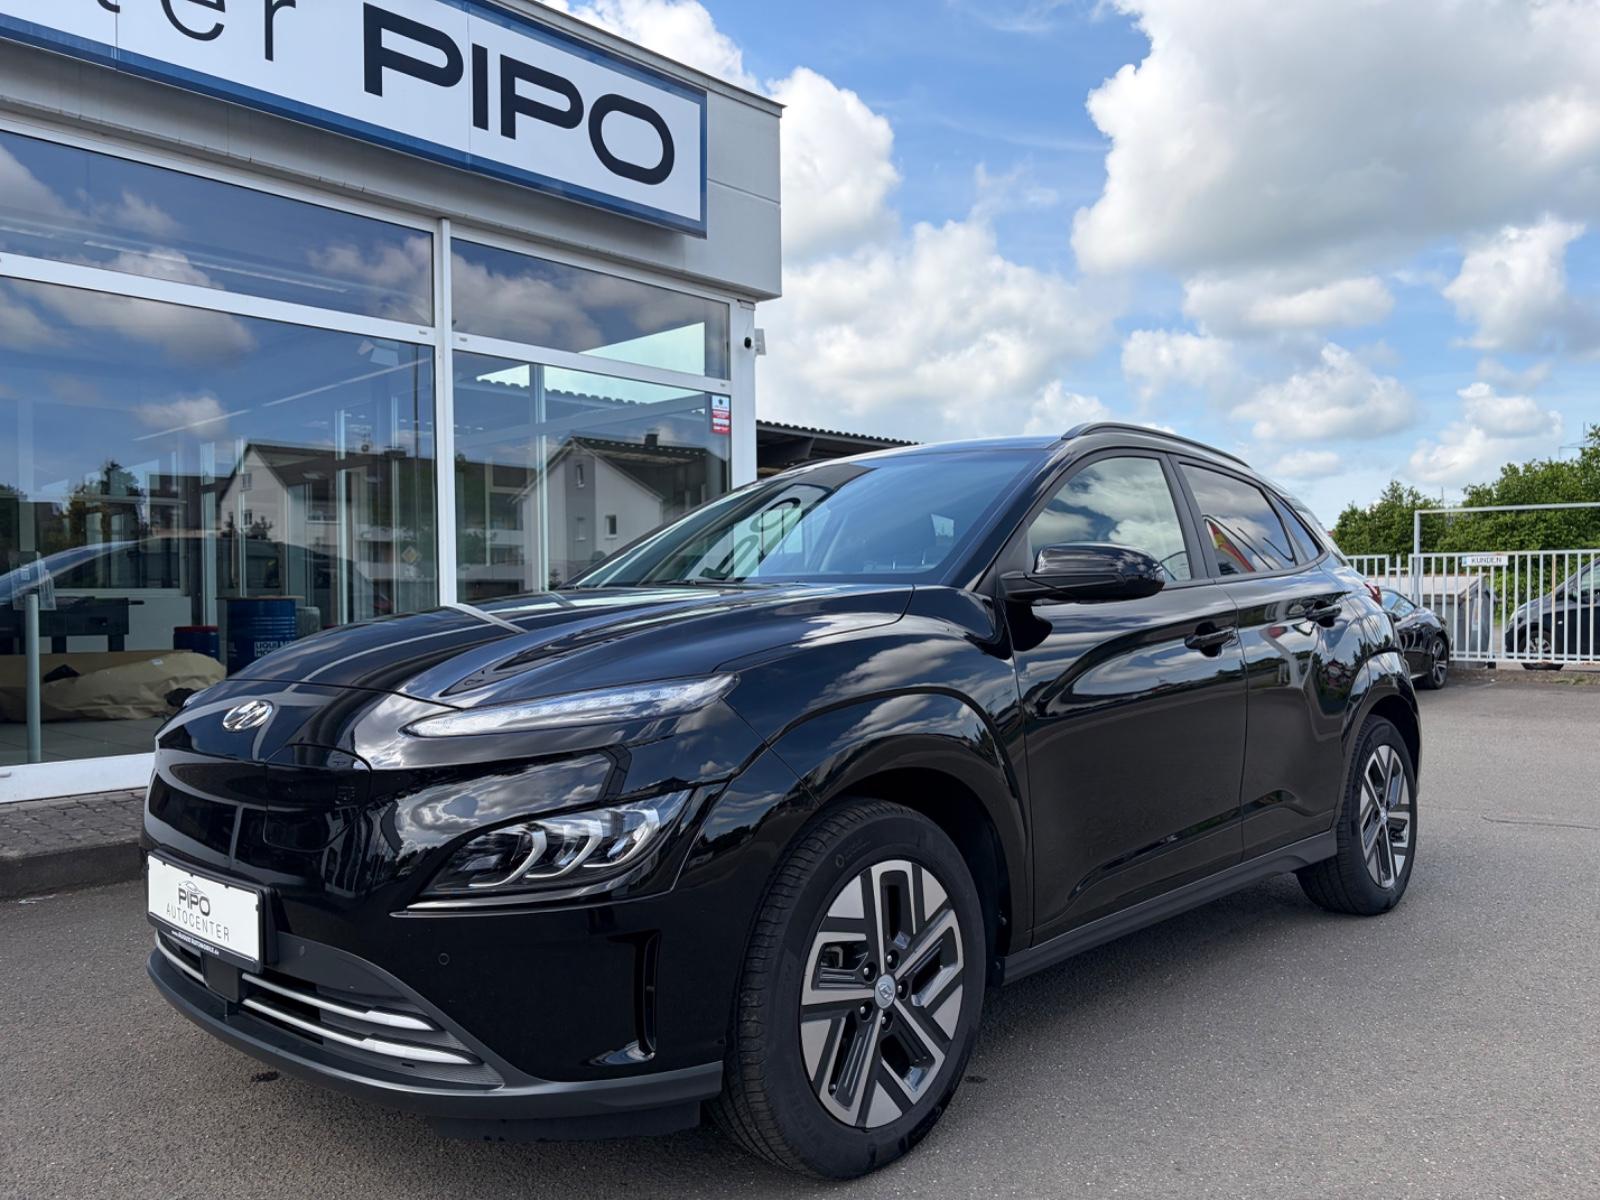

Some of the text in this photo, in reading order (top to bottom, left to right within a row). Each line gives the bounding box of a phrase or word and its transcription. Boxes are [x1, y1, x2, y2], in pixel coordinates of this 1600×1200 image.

[363, 2, 675, 185] PIPO
[178, 888, 210, 916] PIPO
[167, 903, 229, 941] AUTOCENTER
